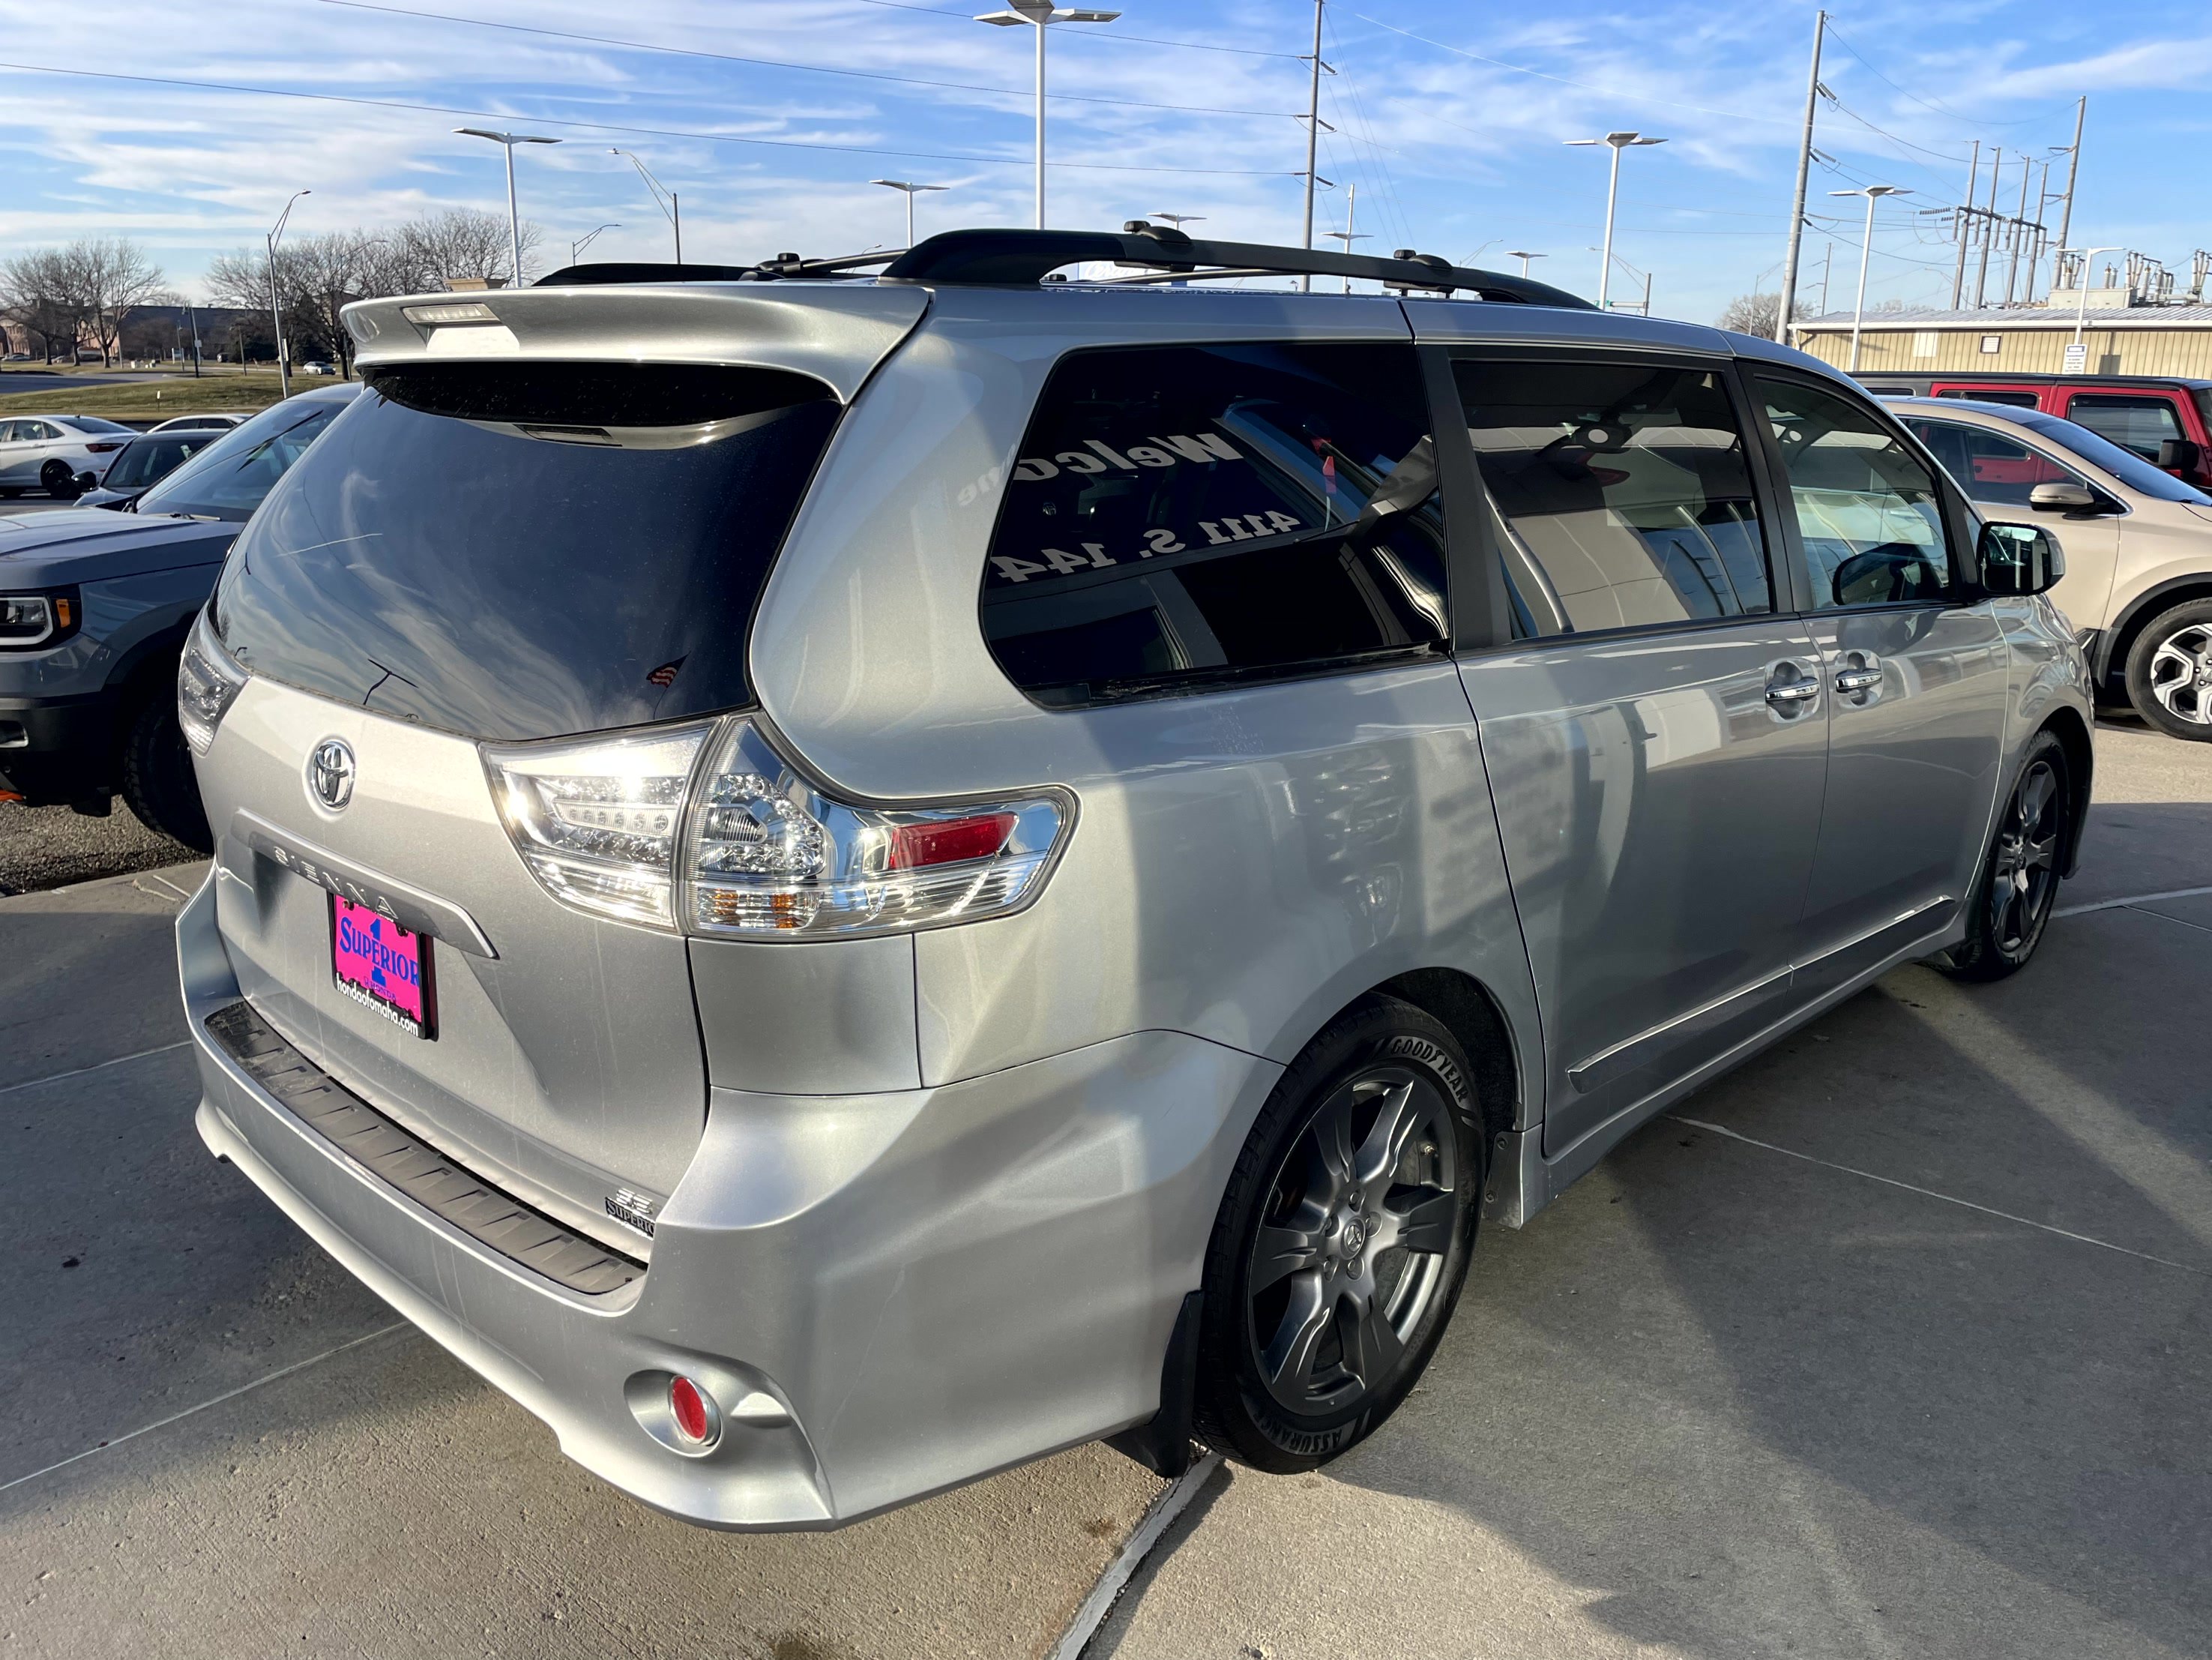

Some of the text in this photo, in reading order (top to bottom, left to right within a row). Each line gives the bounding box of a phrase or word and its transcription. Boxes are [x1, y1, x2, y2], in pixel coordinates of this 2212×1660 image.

[273, 845, 399, 919] SIENNA
[340, 916, 420, 987] SUPERIOR
[336, 971, 419, 1037] hondaofomaha.com
[606, 1200, 655, 1234] SUPERIO
